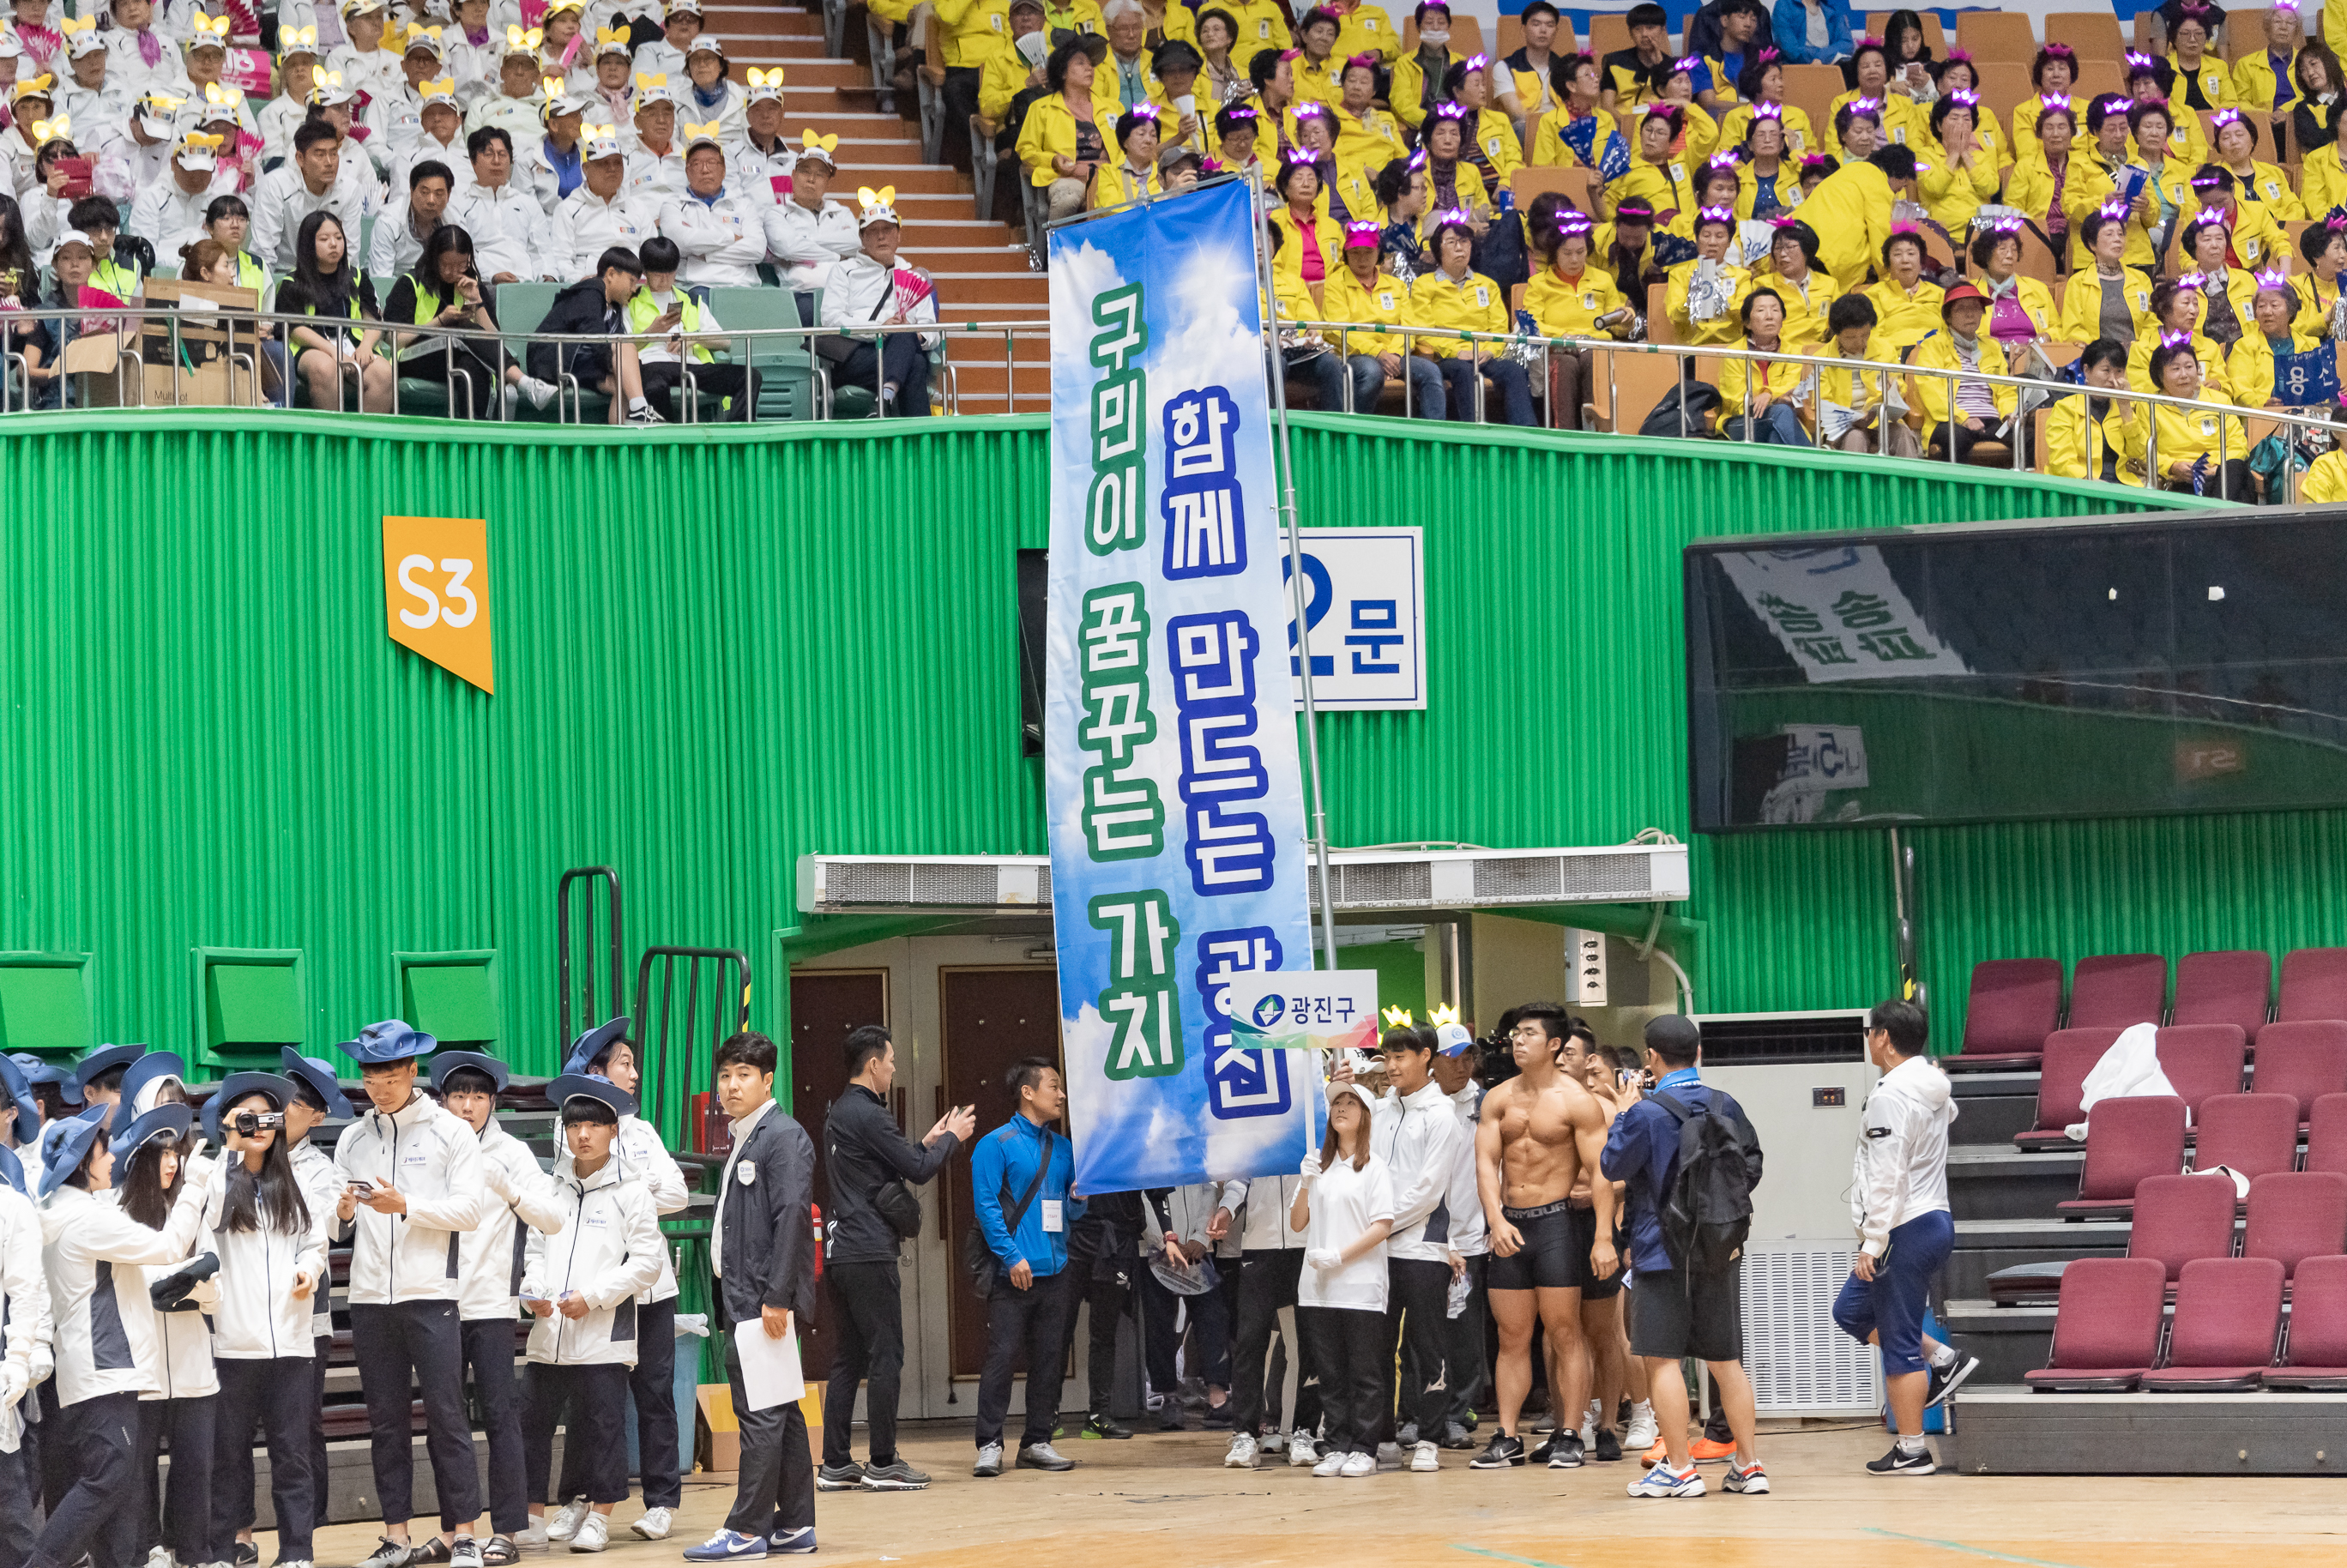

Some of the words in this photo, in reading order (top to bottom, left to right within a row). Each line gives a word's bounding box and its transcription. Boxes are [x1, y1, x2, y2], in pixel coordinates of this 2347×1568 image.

[1084, 281, 1149, 557] 구민이
[1161, 385, 1248, 581] 함께
[398, 553, 478, 630] S3
[1077, 582, 1165, 863] 꿈꾸는
[1167, 610, 1276, 896] 만드는
[1088, 888, 1186, 1081] 가치
[1290, 996, 1355, 1025] 광진구
